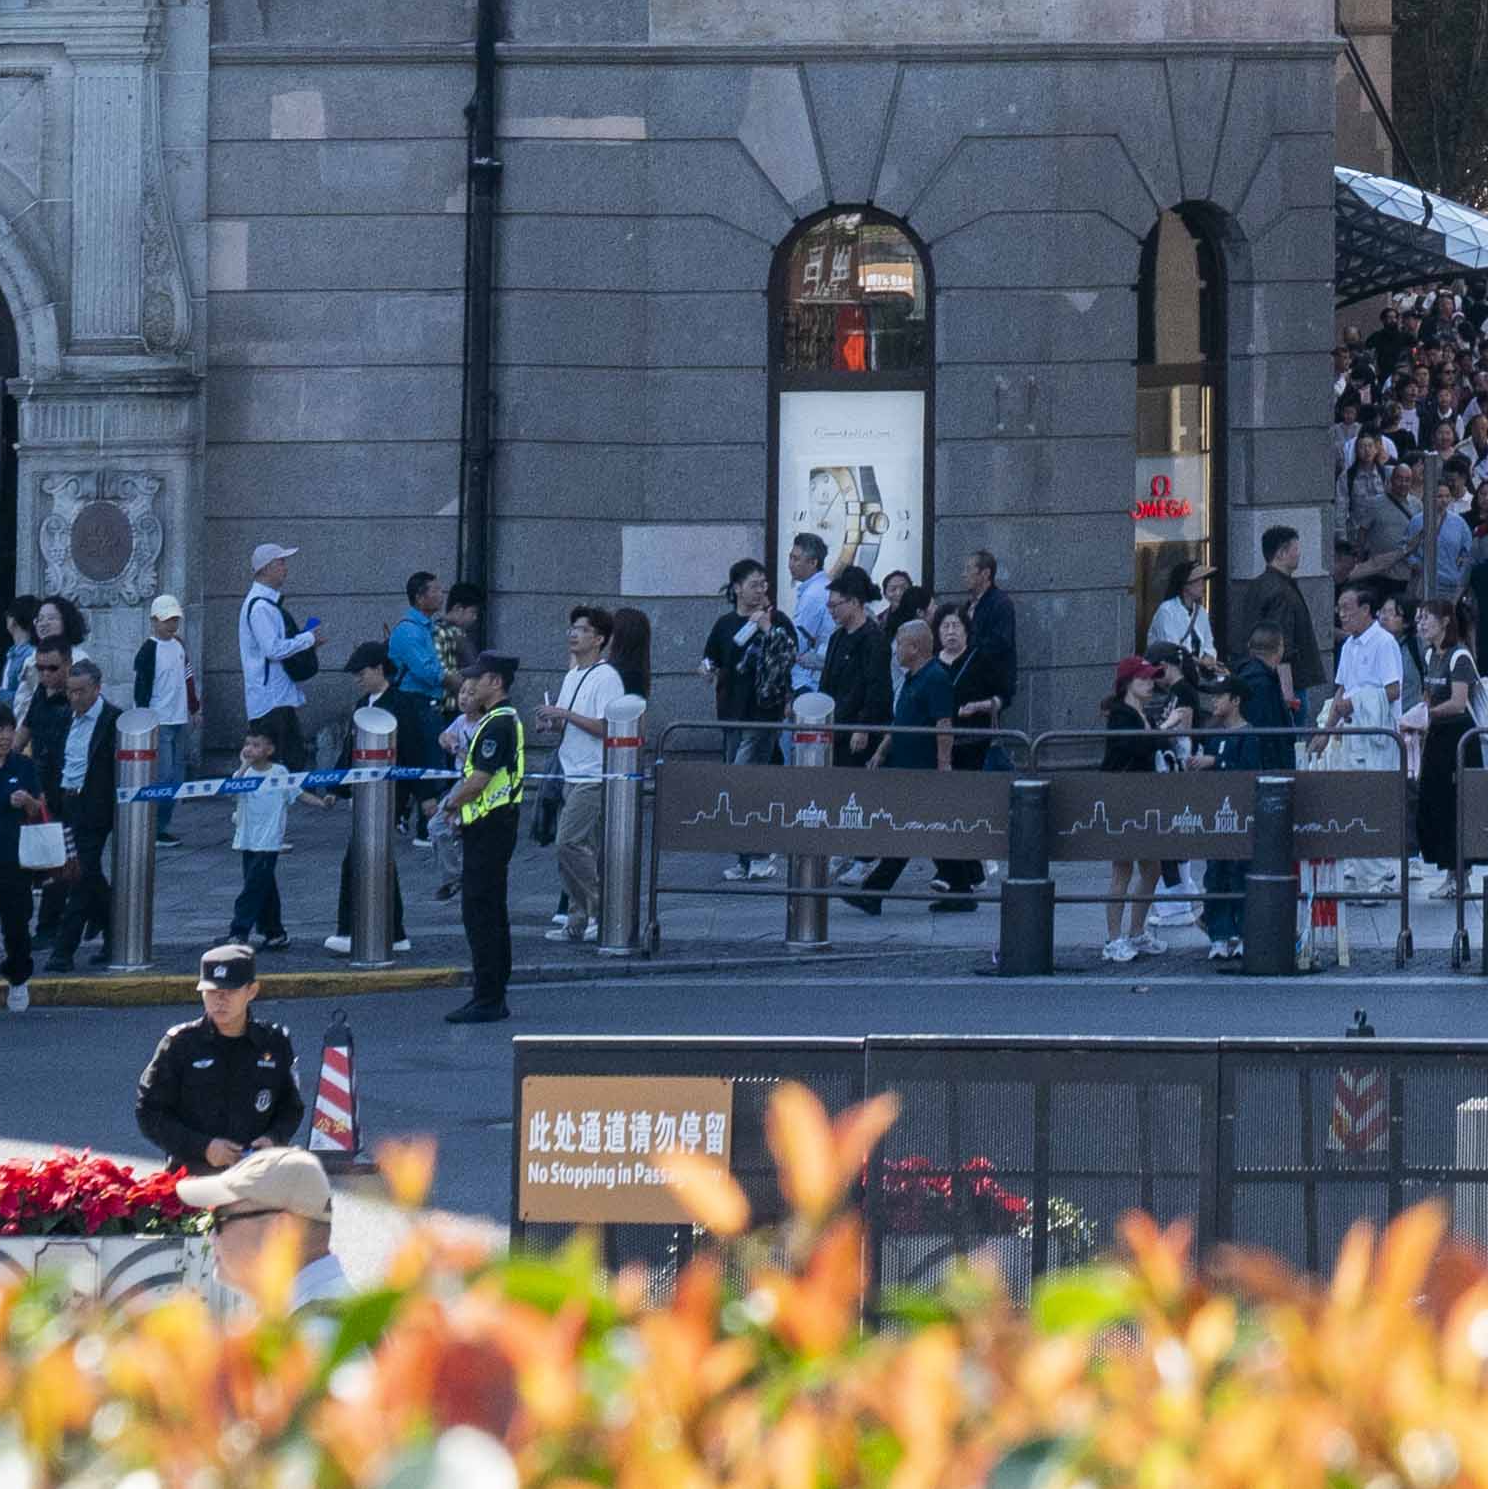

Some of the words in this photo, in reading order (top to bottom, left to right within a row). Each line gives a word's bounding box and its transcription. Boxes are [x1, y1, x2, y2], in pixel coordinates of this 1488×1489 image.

[224, 778, 257, 791] POLICE
[307, 772, 342, 784] POLICE
[140, 787, 174, 799] POLICE
[527, 1109, 726, 1156] 此处通道请勿停留
[527, 1161, 548, 1184] No
[550, 1162, 615, 1189] Stopping
[618, 1161, 631, 1184] in
